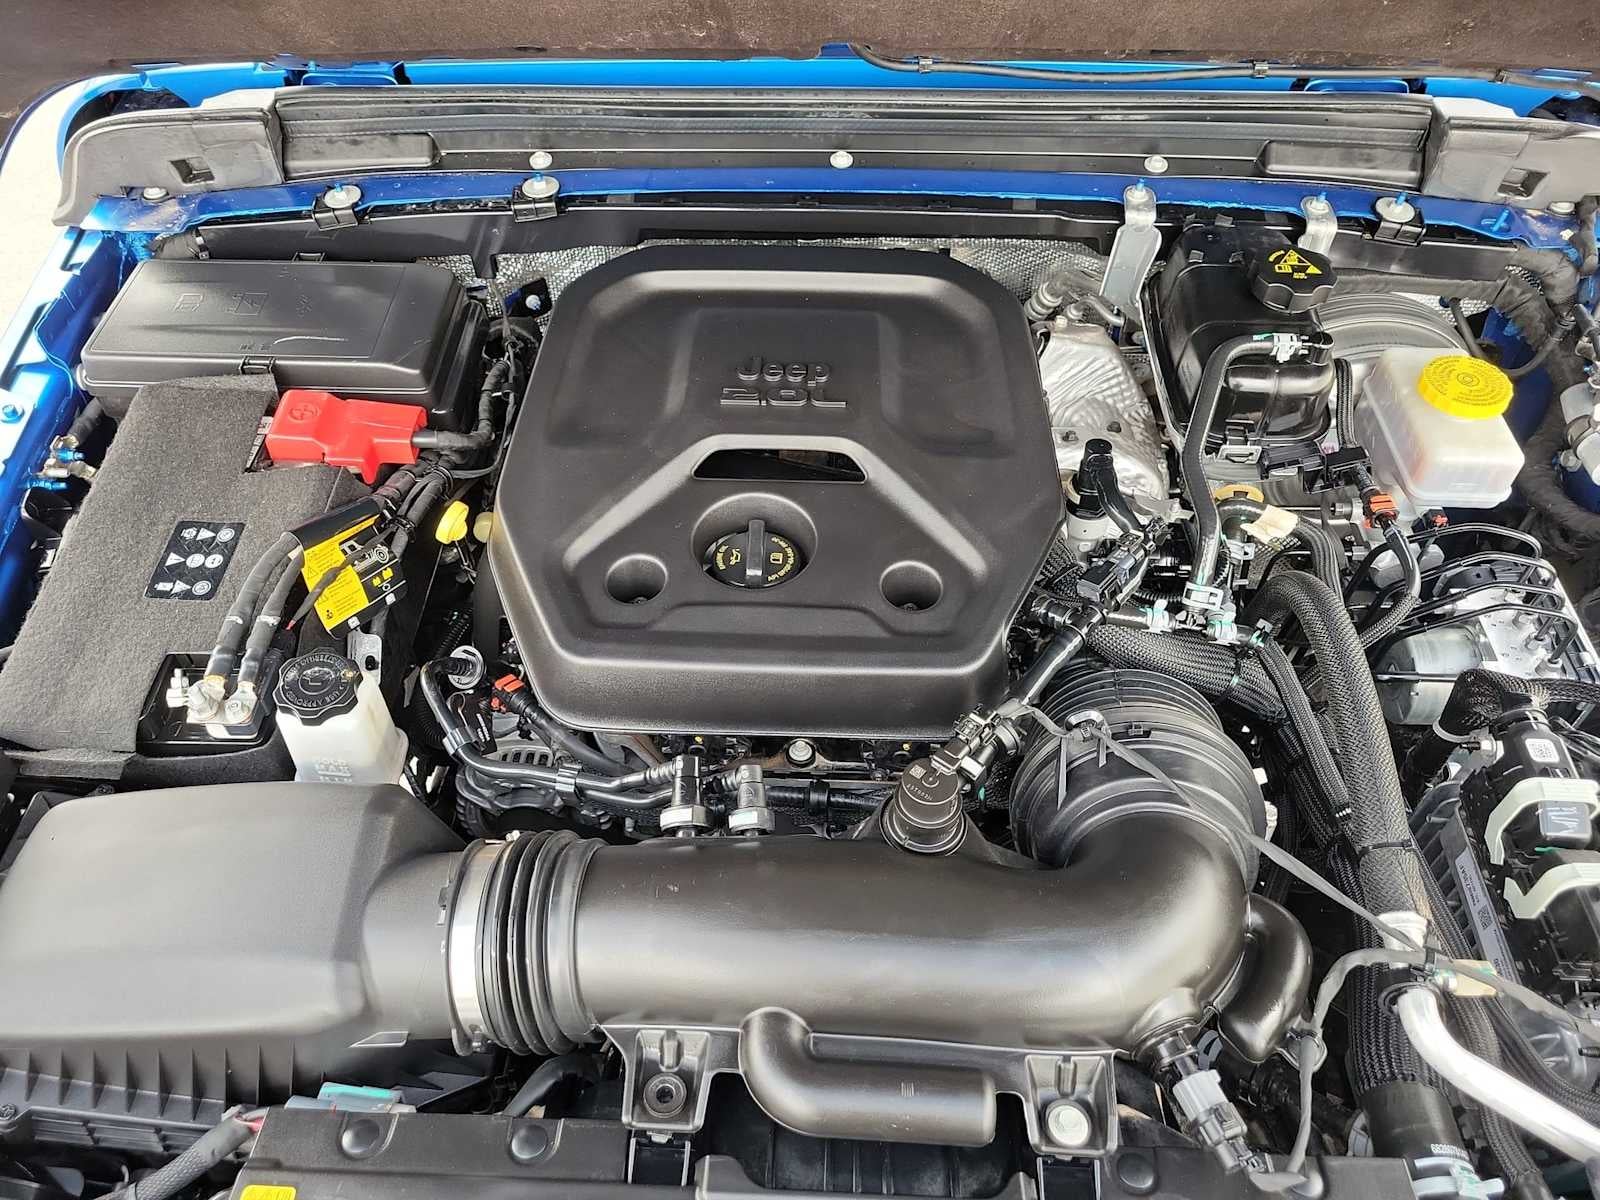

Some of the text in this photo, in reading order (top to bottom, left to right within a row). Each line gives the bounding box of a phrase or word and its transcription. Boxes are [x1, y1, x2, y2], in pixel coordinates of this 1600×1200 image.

[736, 357, 829, 386] Jeep
[720, 387, 847, 407] 2.0L
[285, 690, 322, 708] APPROVED
